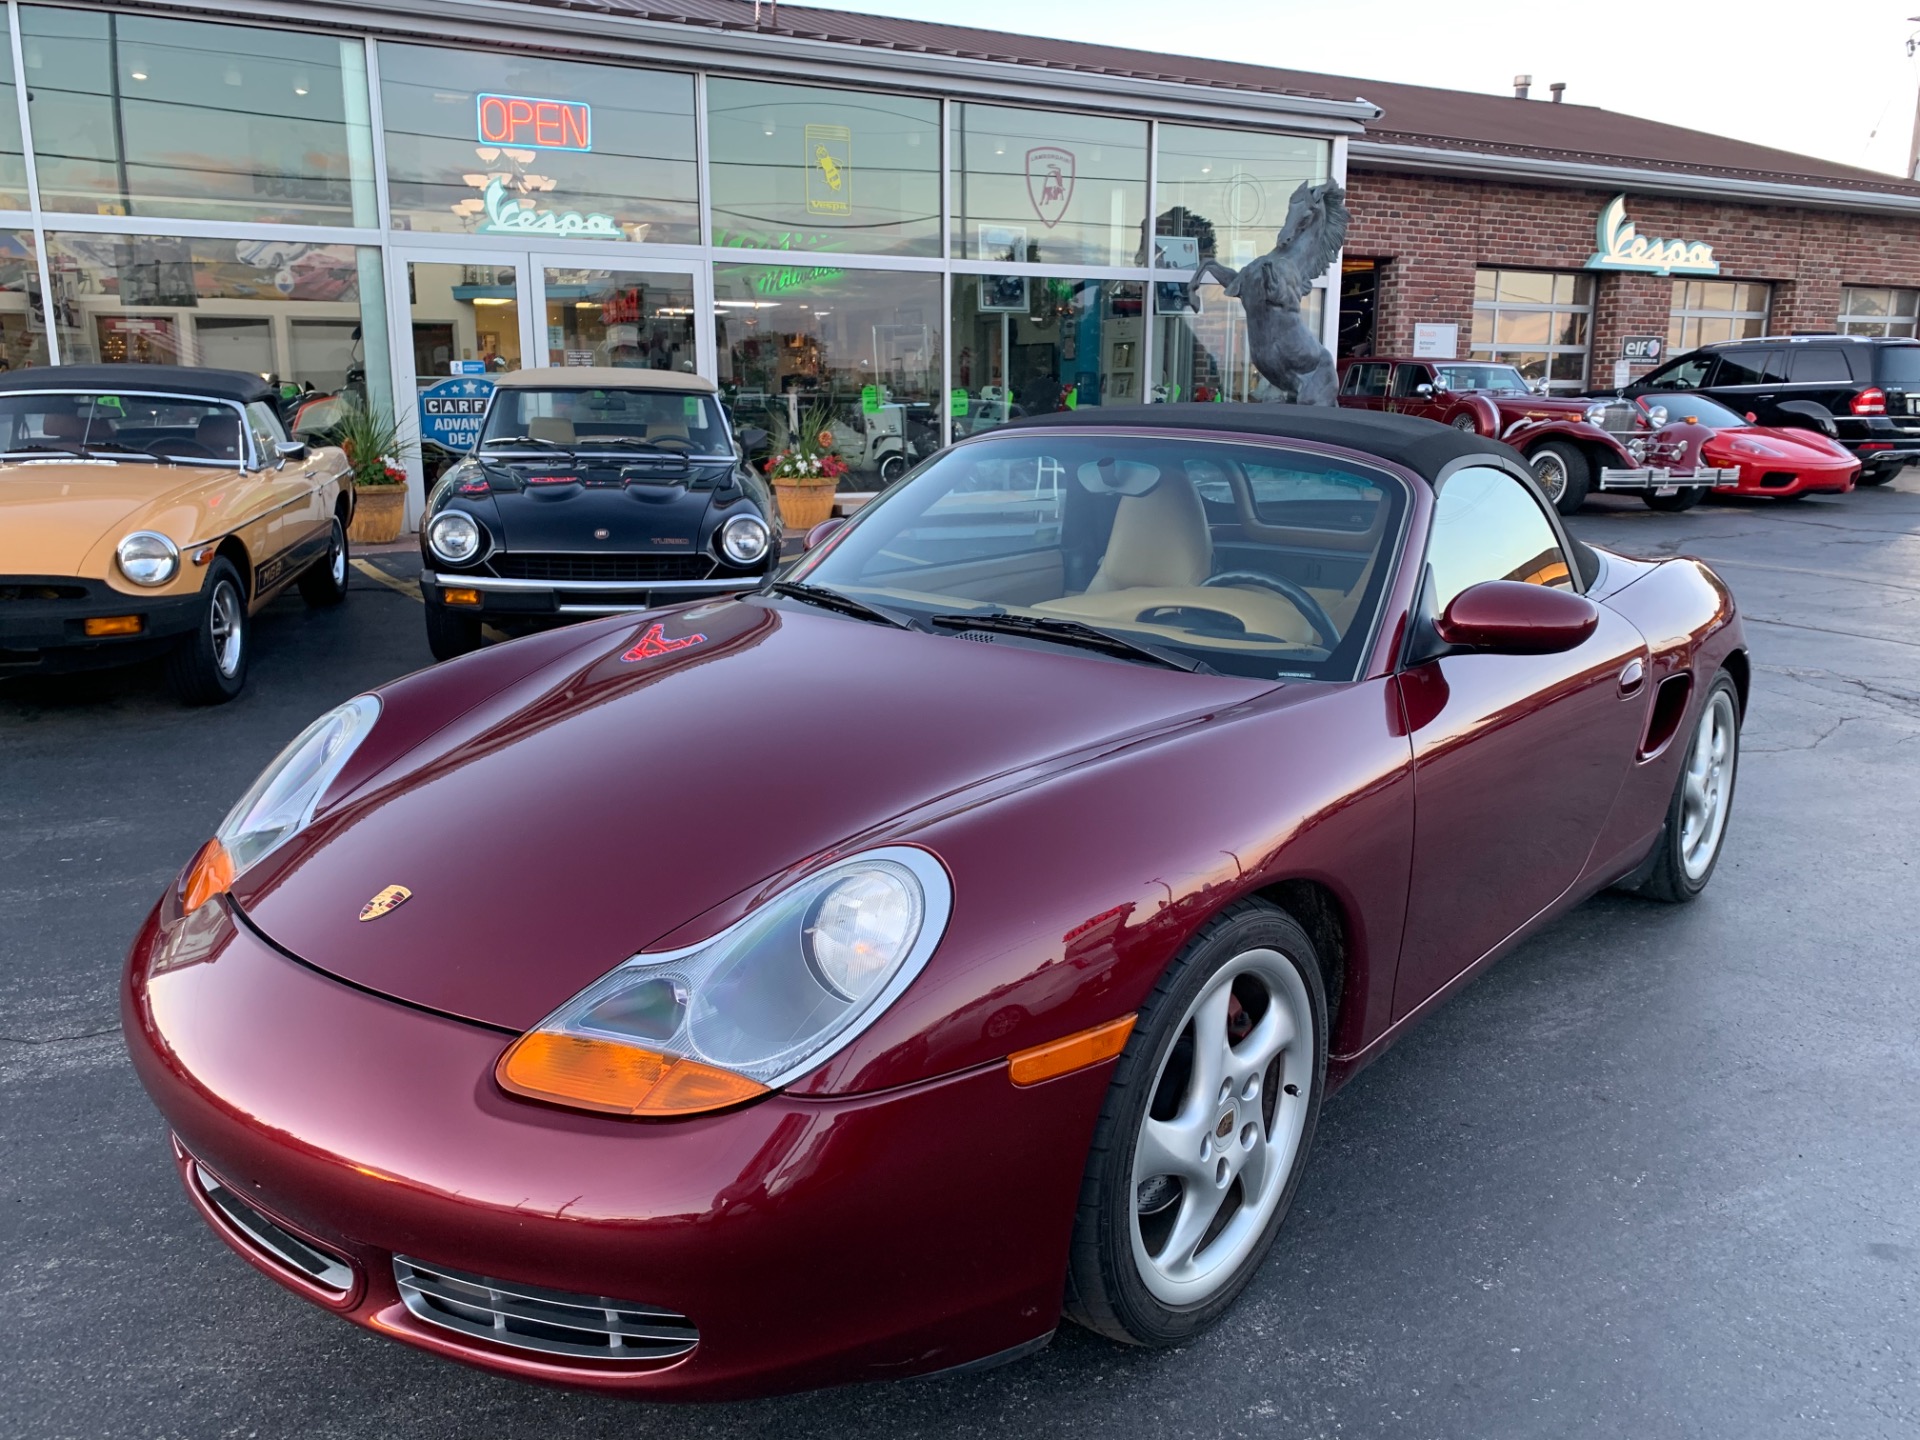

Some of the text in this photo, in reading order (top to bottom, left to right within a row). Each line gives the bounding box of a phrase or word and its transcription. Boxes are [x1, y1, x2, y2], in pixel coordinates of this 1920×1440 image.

[482, 98, 586, 148] OPEN
[485, 177, 621, 237] Vespa
[810, 200, 848, 211] Vespa
[1598, 195, 1718, 273] Vespa
[1625, 341, 1648, 355] elf
[428, 400, 484, 413] CARF
[434, 417, 484, 431] ADVANT
[448, 432, 479, 445] DEA
